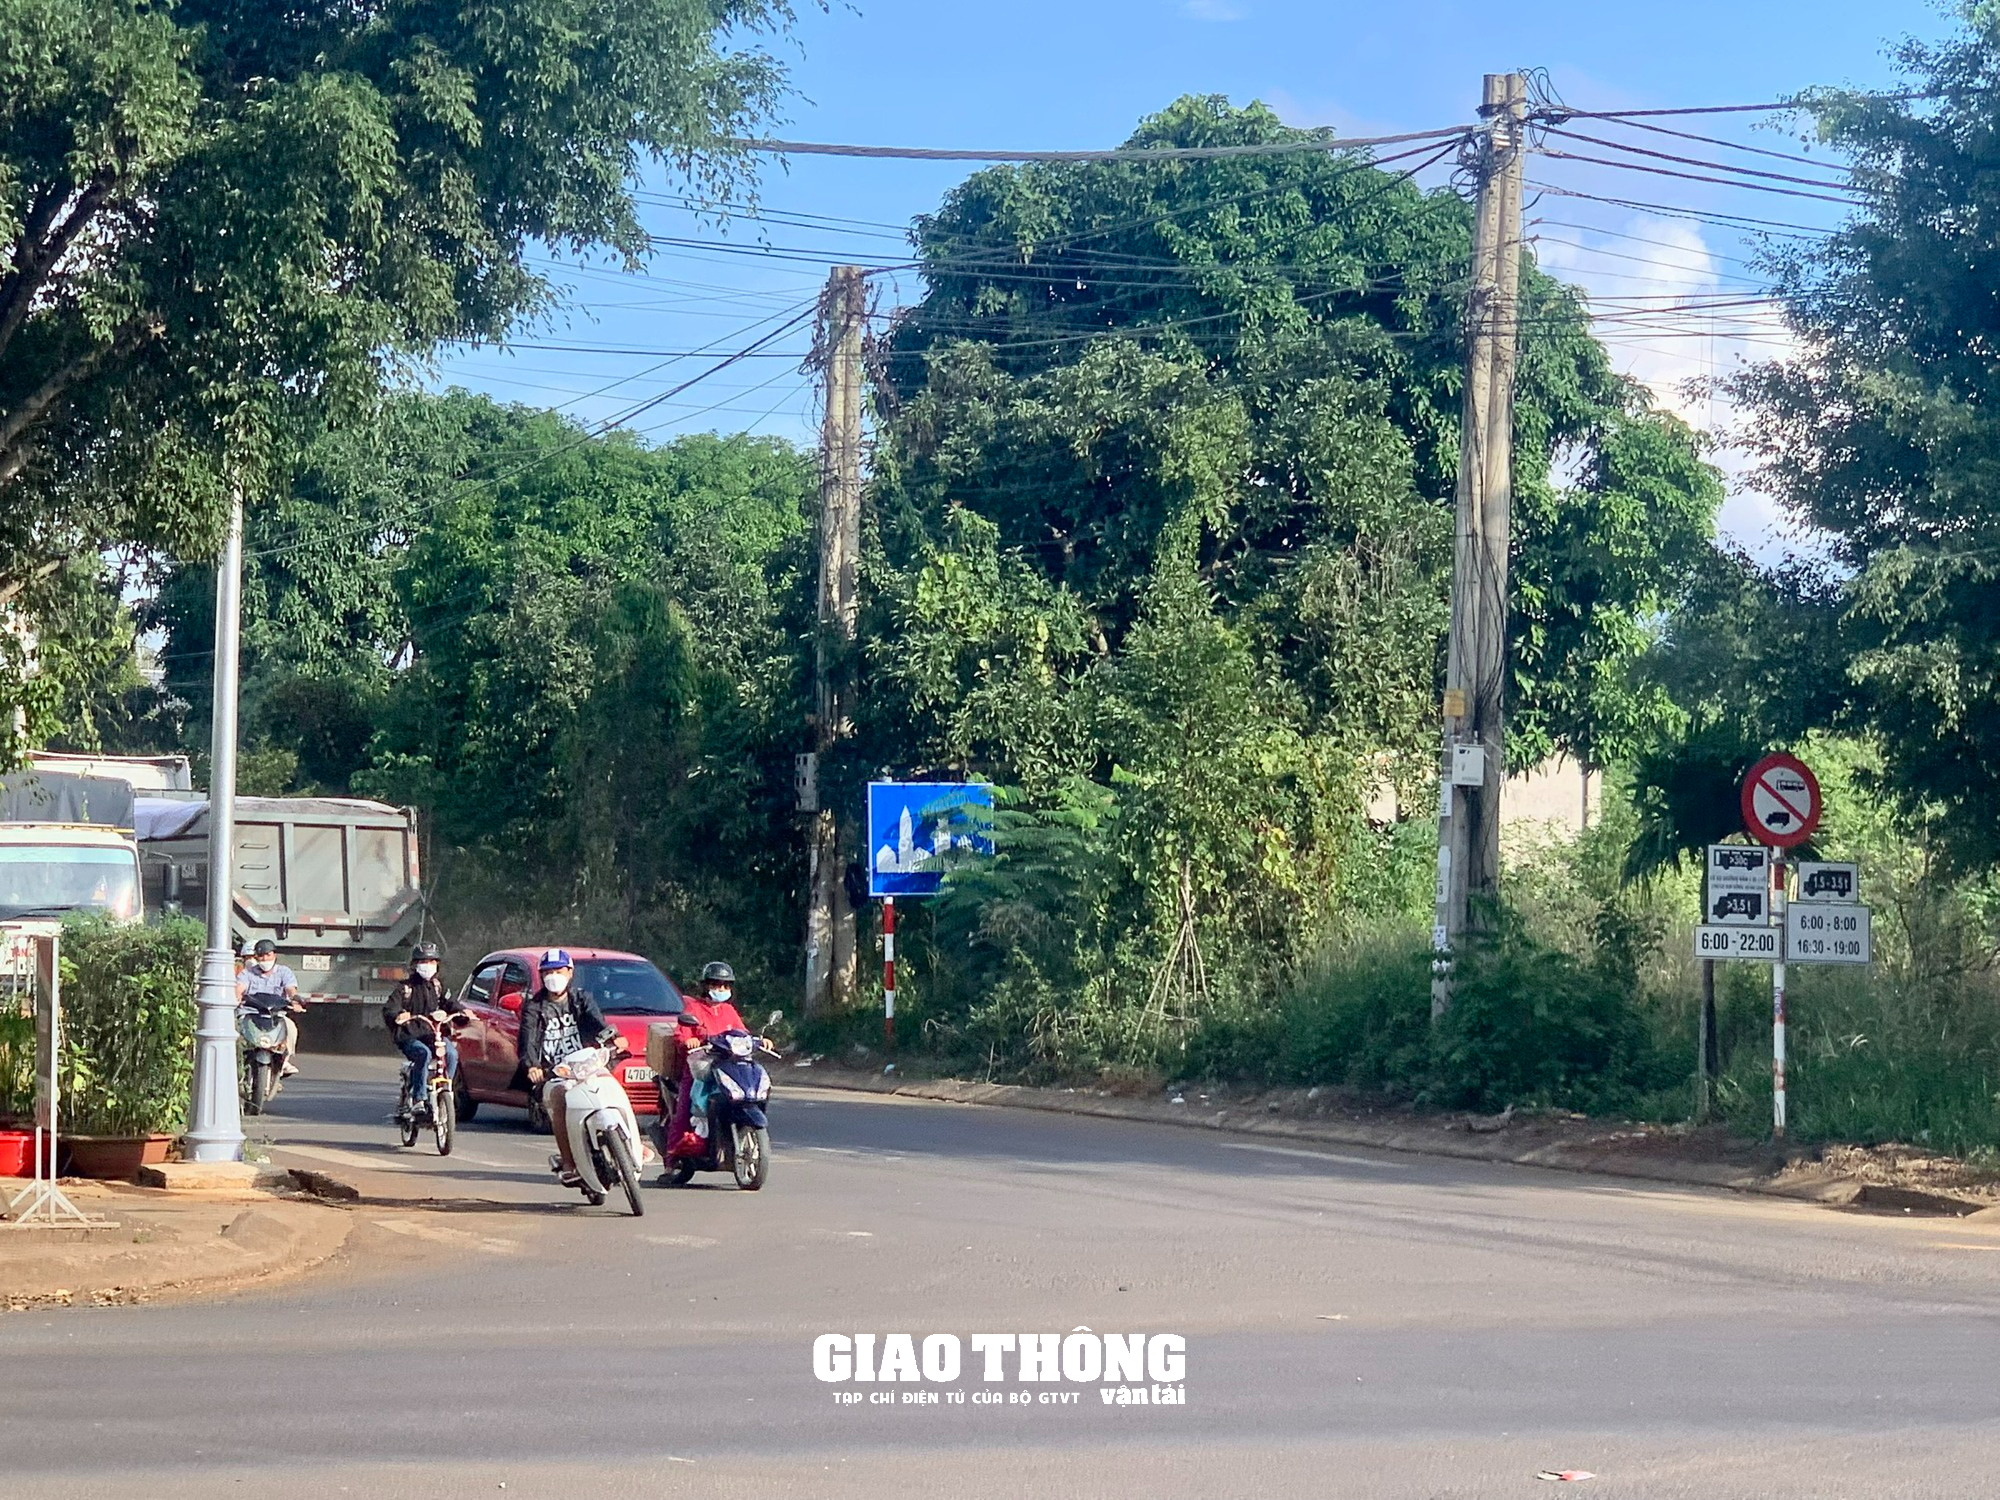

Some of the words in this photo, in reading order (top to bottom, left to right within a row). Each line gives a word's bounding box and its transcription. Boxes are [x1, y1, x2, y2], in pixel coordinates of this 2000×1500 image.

[1801, 915, 1824, 930] 6:00
[1833, 916, 1857, 931] 8:00
[1701, 932, 1729, 950] 6:00
[1740, 933, 1774, 951] 22:00
[1798, 939, 1824, 954] 16:30
[1834, 940, 1860, 955] 19:00
